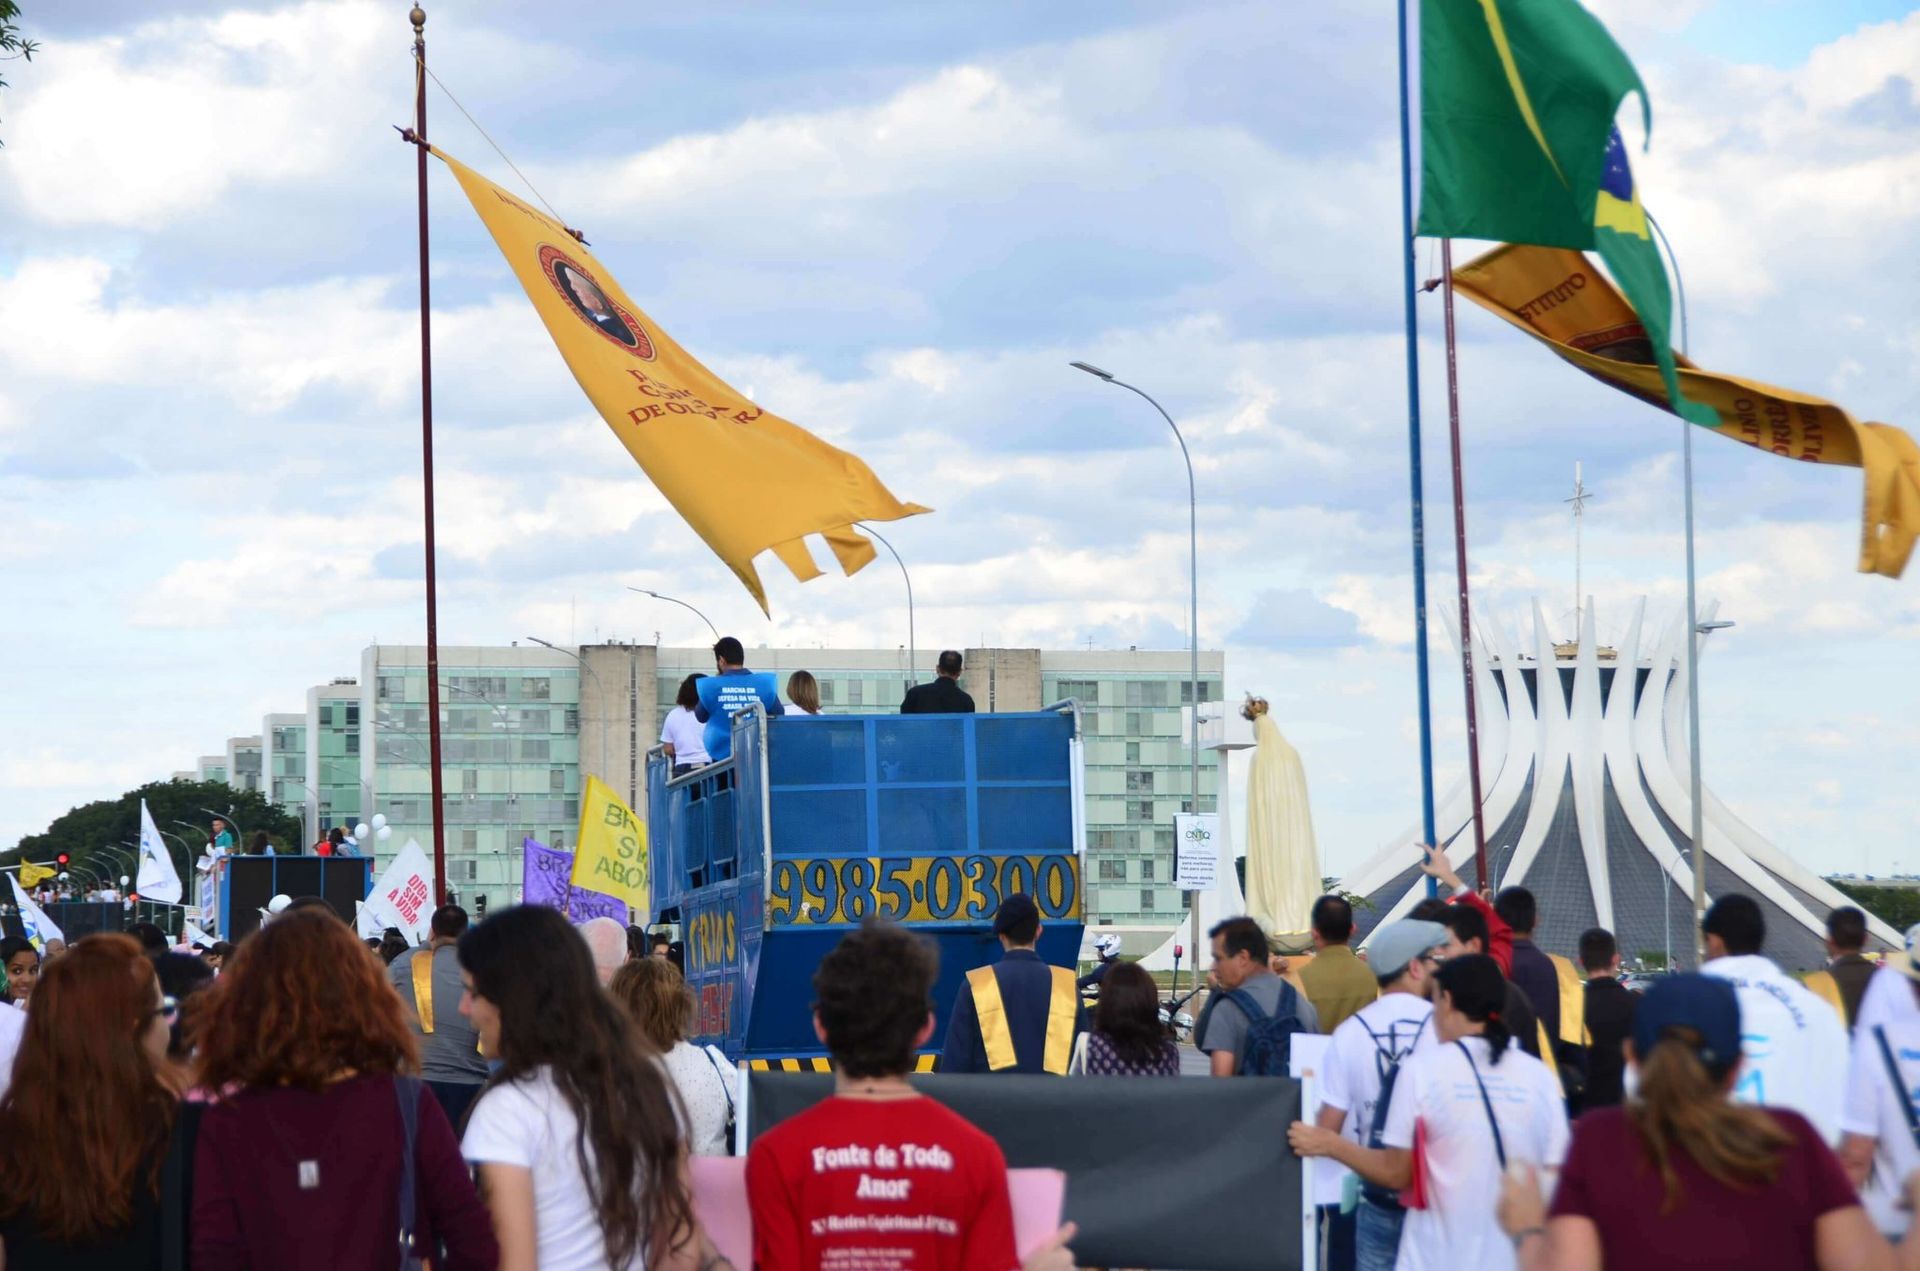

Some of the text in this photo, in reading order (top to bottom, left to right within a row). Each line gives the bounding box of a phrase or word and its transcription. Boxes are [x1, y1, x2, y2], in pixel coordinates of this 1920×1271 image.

[627, 404, 665, 426] DE
[1185, 830, 1211, 841] CNTQ
[403, 886, 423, 910] SIM
[811, 1143, 954, 1173] Fonte de Todo
[856, 1173, 912, 1200] Amor
